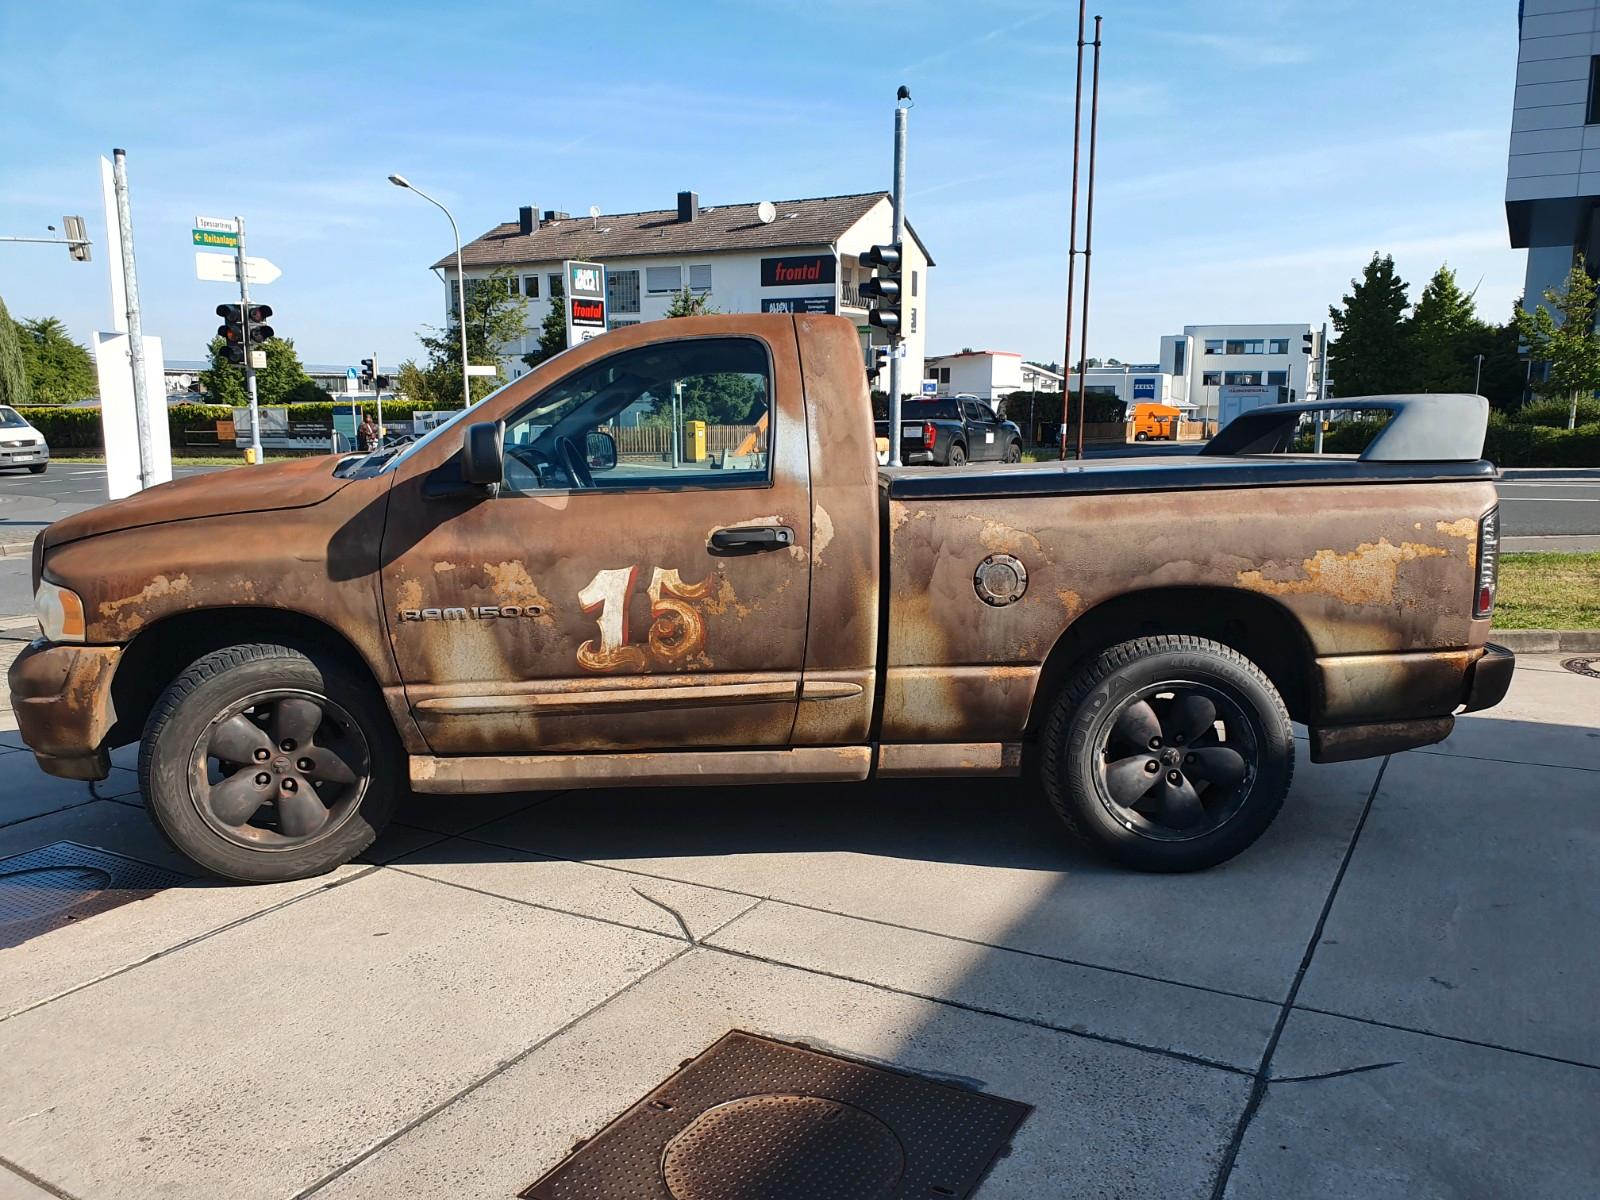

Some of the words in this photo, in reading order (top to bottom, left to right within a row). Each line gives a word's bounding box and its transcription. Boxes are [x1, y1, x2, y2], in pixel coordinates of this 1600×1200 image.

[775, 260, 822, 281] frontal
[573, 301, 602, 318] frontal
[471, 605, 546, 620] 1500
[576, 564, 714, 672] 15
[1069, 675, 1133, 770] FULDA
